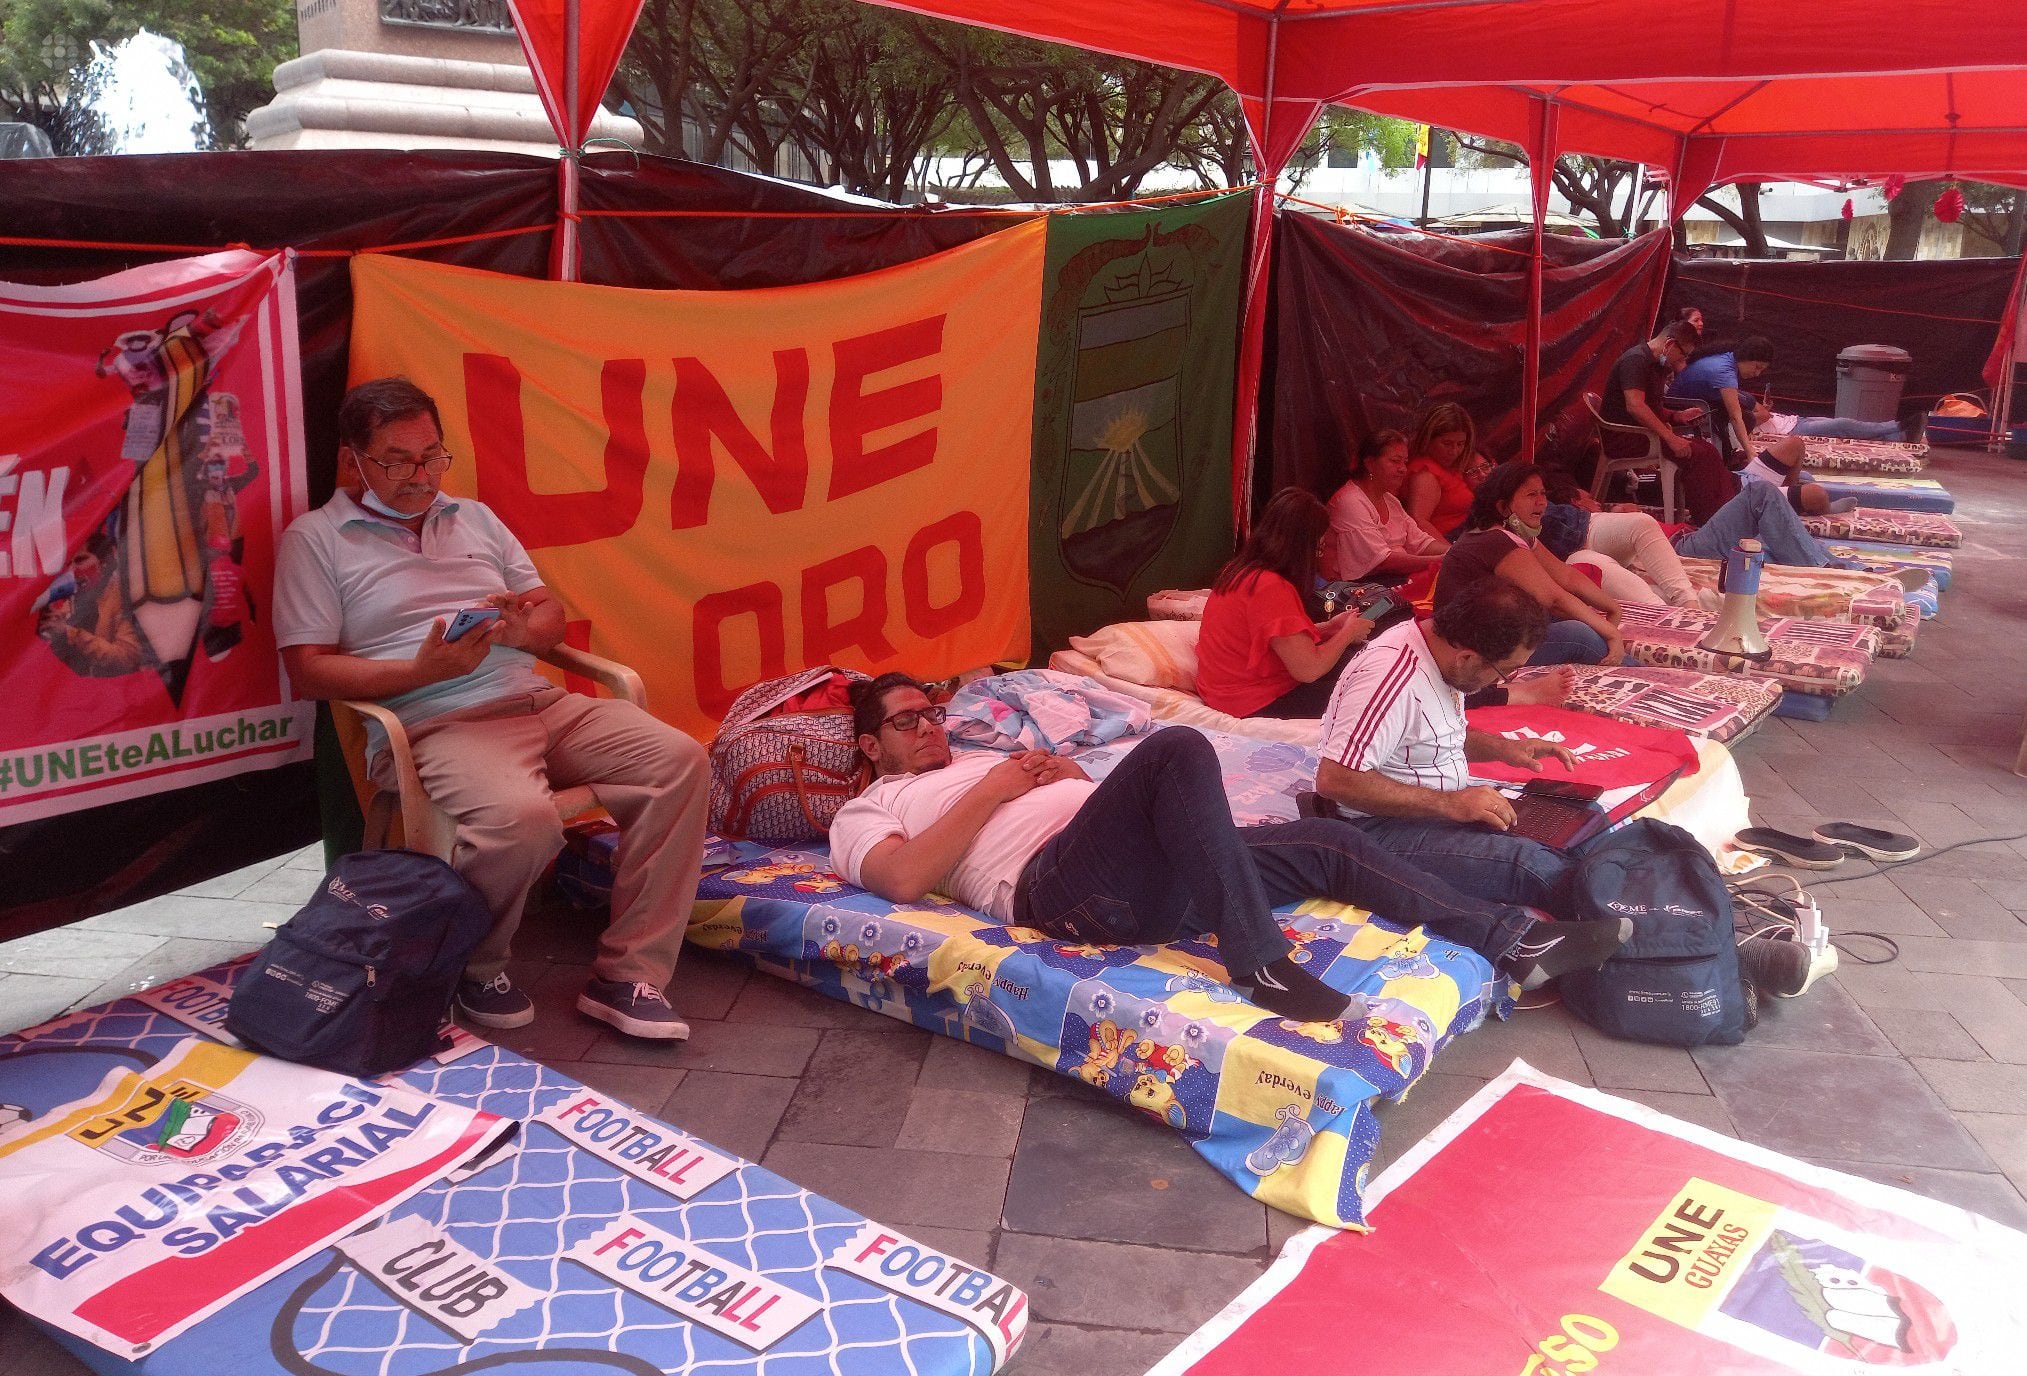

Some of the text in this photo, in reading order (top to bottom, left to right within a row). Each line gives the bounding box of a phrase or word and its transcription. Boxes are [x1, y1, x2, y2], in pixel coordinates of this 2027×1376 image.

[463, 313, 948, 550] UNE
[693, 511, 985, 718] ORO
[0, 716, 293, 791] #UNEteALuchar
[1255, 1071, 1311, 1100] everday
[162, 1102, 436, 1254] SALARIAL
[557, 1098, 704, 1185] FOOTBALL
[382, 1239, 508, 1318] CLUB
[593, 1227, 781, 1332] FOOTBALL
[1629, 1198, 1725, 1283] UNE
[1684, 1223, 1749, 1289] GUAYAS
